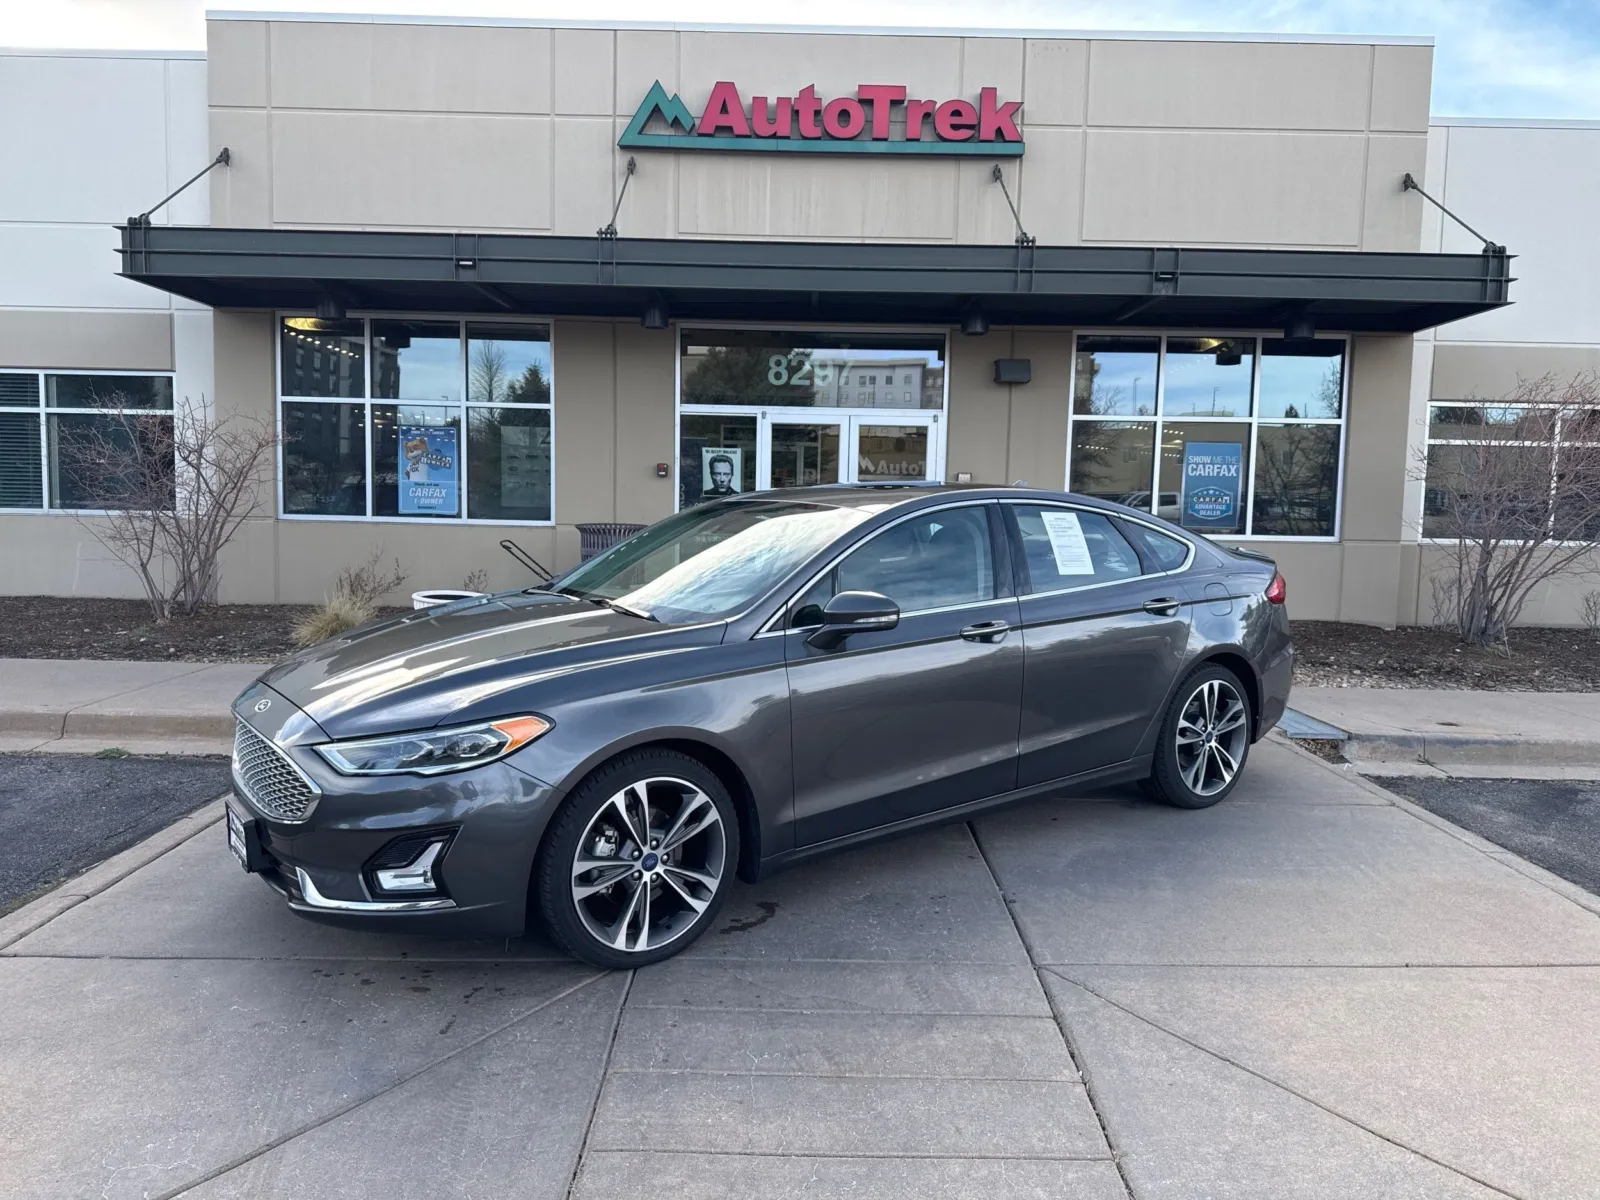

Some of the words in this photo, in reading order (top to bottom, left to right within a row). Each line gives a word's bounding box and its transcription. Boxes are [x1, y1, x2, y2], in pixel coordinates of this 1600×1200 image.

[697, 81, 1024, 142] AutoTrek
[768, 354, 855, 386] 8297
[1225, 456, 1239, 464] THE
[1188, 464, 1237, 476] CARFAX
[409, 488, 447, 498] CARFAX
